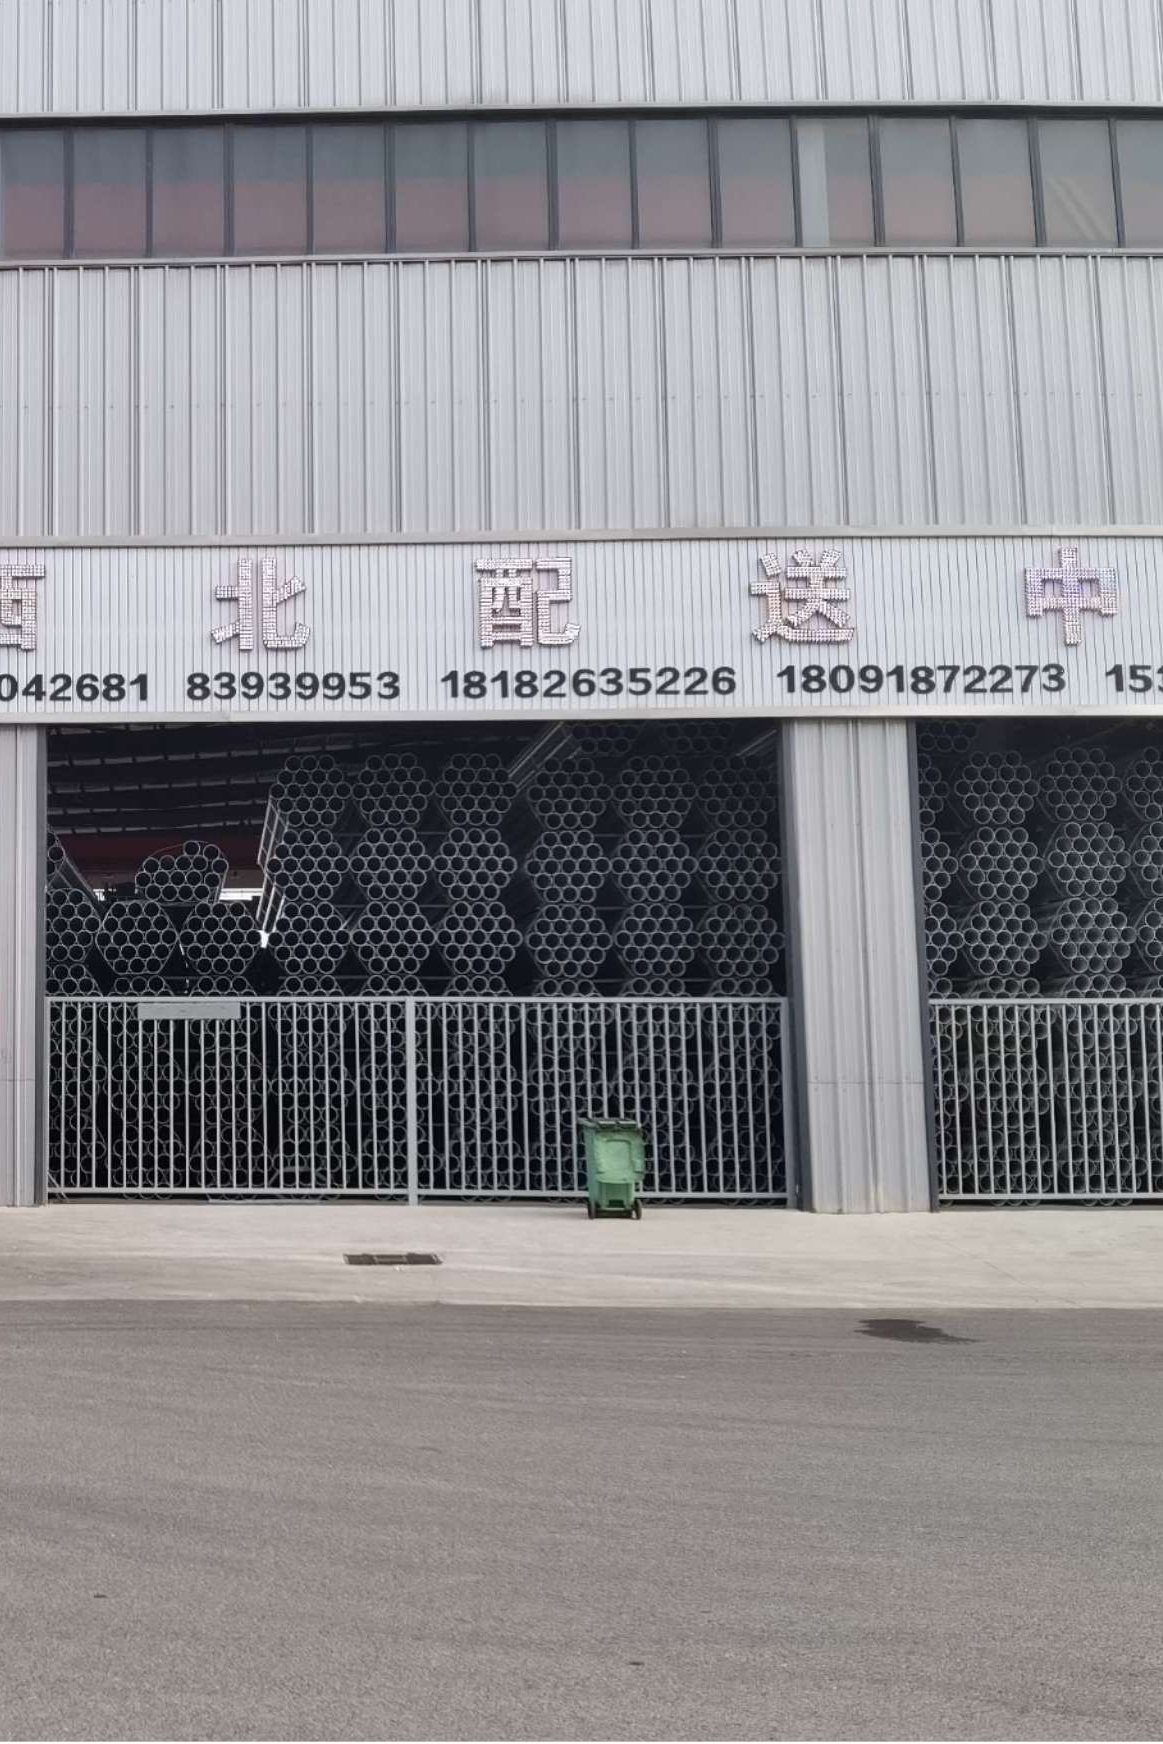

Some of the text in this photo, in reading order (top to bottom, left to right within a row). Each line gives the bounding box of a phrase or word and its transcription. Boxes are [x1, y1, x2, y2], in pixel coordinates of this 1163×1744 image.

[186, 671, 401, 701] 83939953
[440, 667, 737, 699] 18182635226
[776, 664, 1067, 694] 18091872273
[1105, 664, 1163, 693] 15
